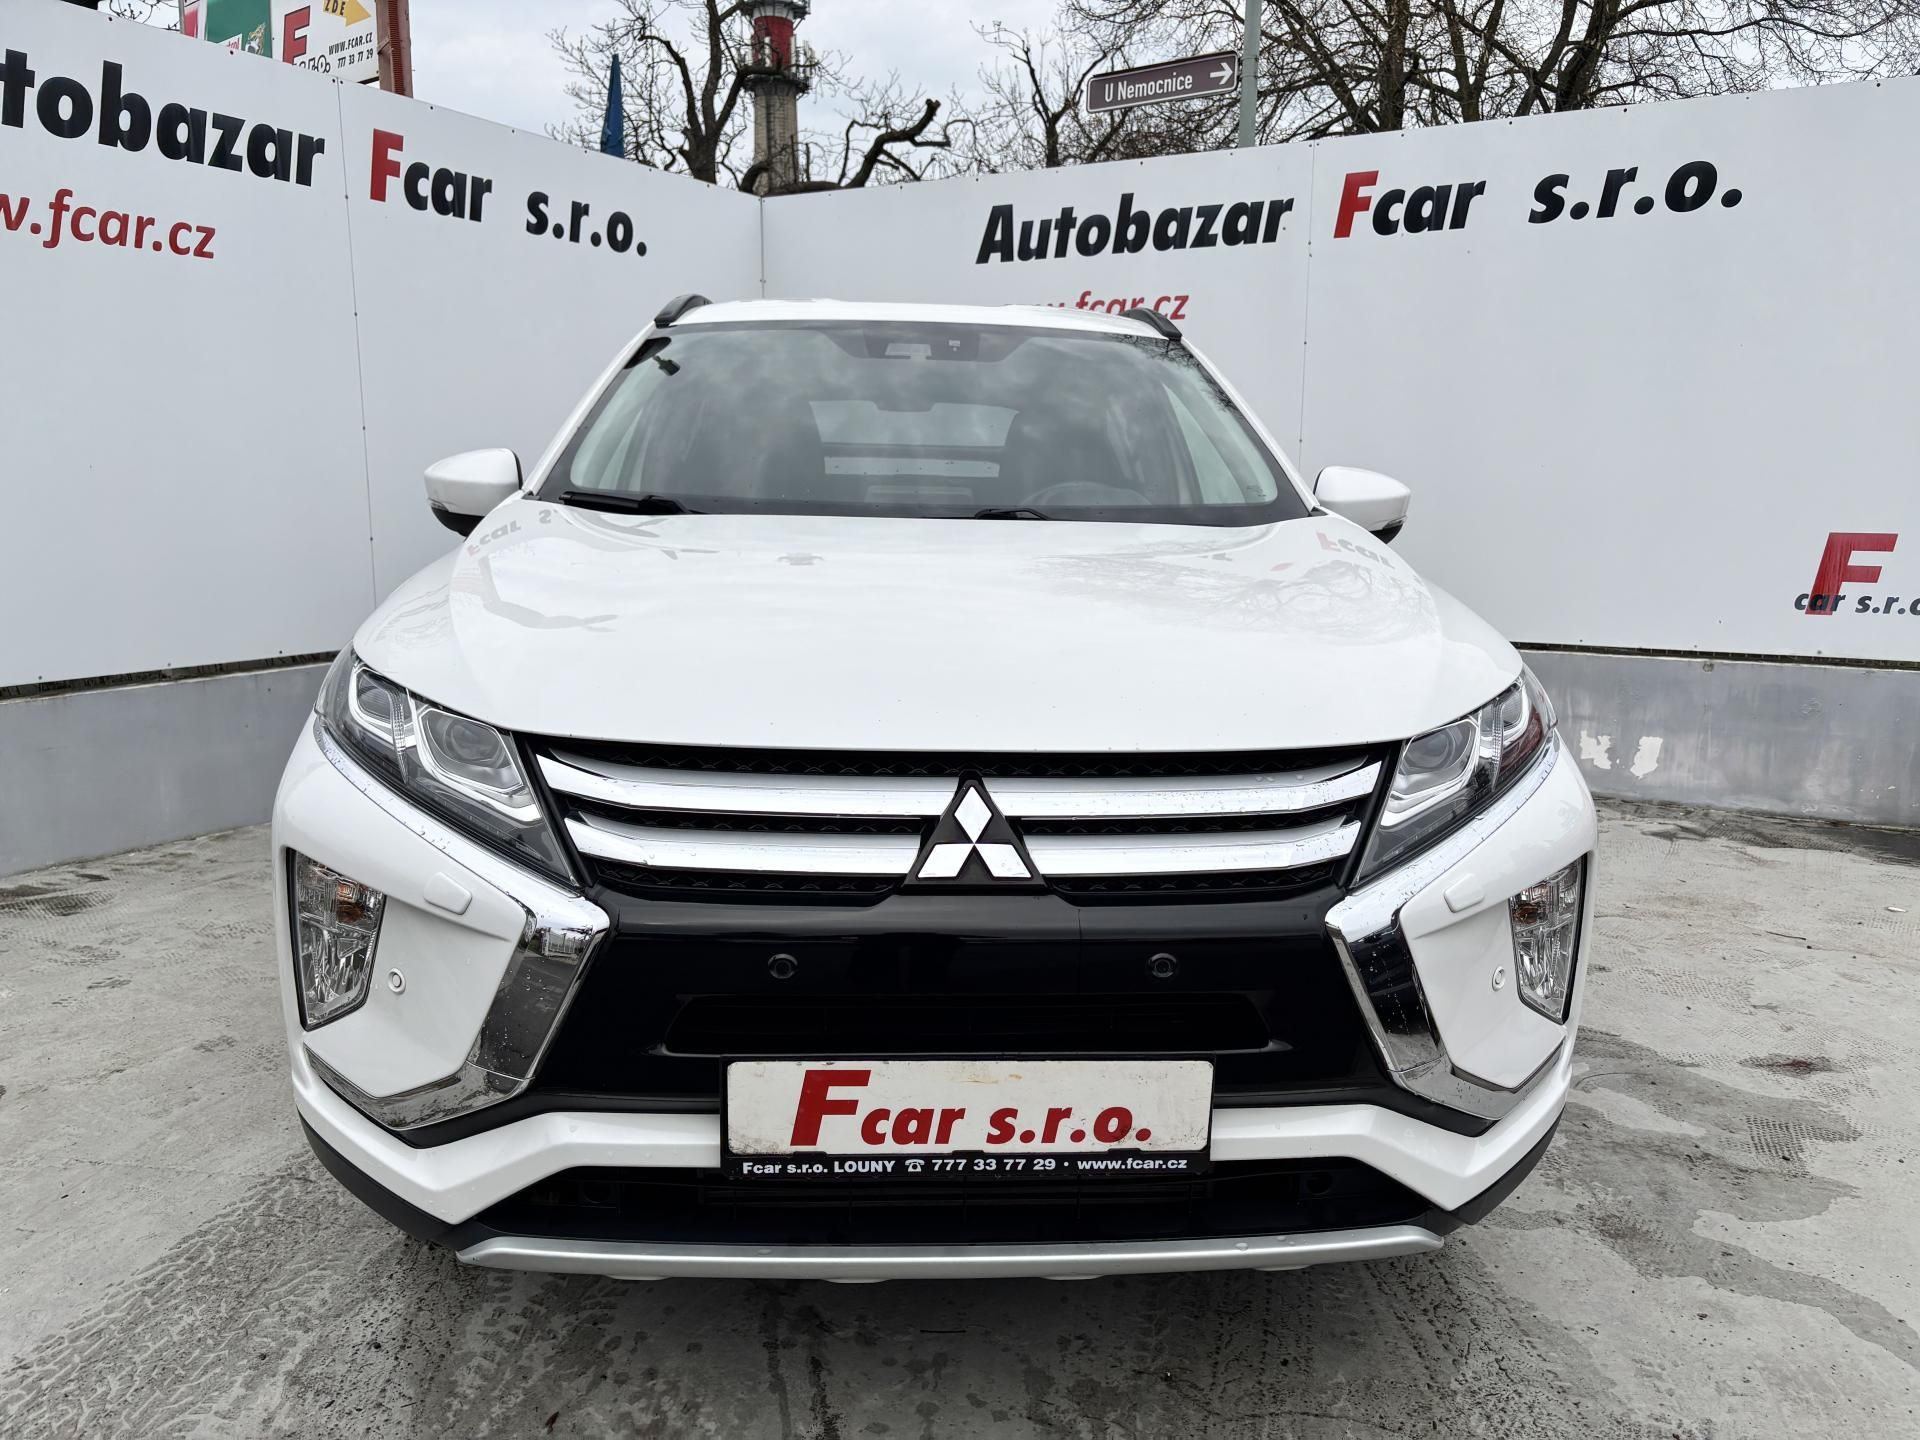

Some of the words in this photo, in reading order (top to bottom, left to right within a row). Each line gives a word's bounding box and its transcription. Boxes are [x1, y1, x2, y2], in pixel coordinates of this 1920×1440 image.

[325, 0, 346, 16] ZDE
[328, 32, 373, 56] WWW.FCAR.CZ
[337, 56, 346, 69] 777
[348, 53, 355, 65] 33
[357, 51, 364, 63] 77
[366, 48, 374, 60] 29
[1104, 81, 1113, 102] U
[1117, 72, 1193, 101] Nemocnice
[0, 48, 326, 188] tobazar
[370, 128, 493, 222] Fcar
[526, 191, 647, 257] s.r.o.
[975, 193, 1295, 264] Autobazar
[1333, 170, 1487, 239] Fcar
[1528, 160, 1743, 225] s.r.o.
[789, 1069, 966, 1147] Fcar
[985, 1106, 1153, 1145] s.r.o.
[742, 1161, 782, 1174] Fcar
[786, 1162, 828, 1174] s.r.o.
[834, 1160, 896, 1173] LOUNY
[931, 1159, 967, 1171] 777
[973, 1158, 997, 1171] 33
[1003, 1158, 1027, 1171] 77
[1033, 1158, 1057, 1170] 29
[1077, 1157, 1188, 1170] www.fcar.cz
